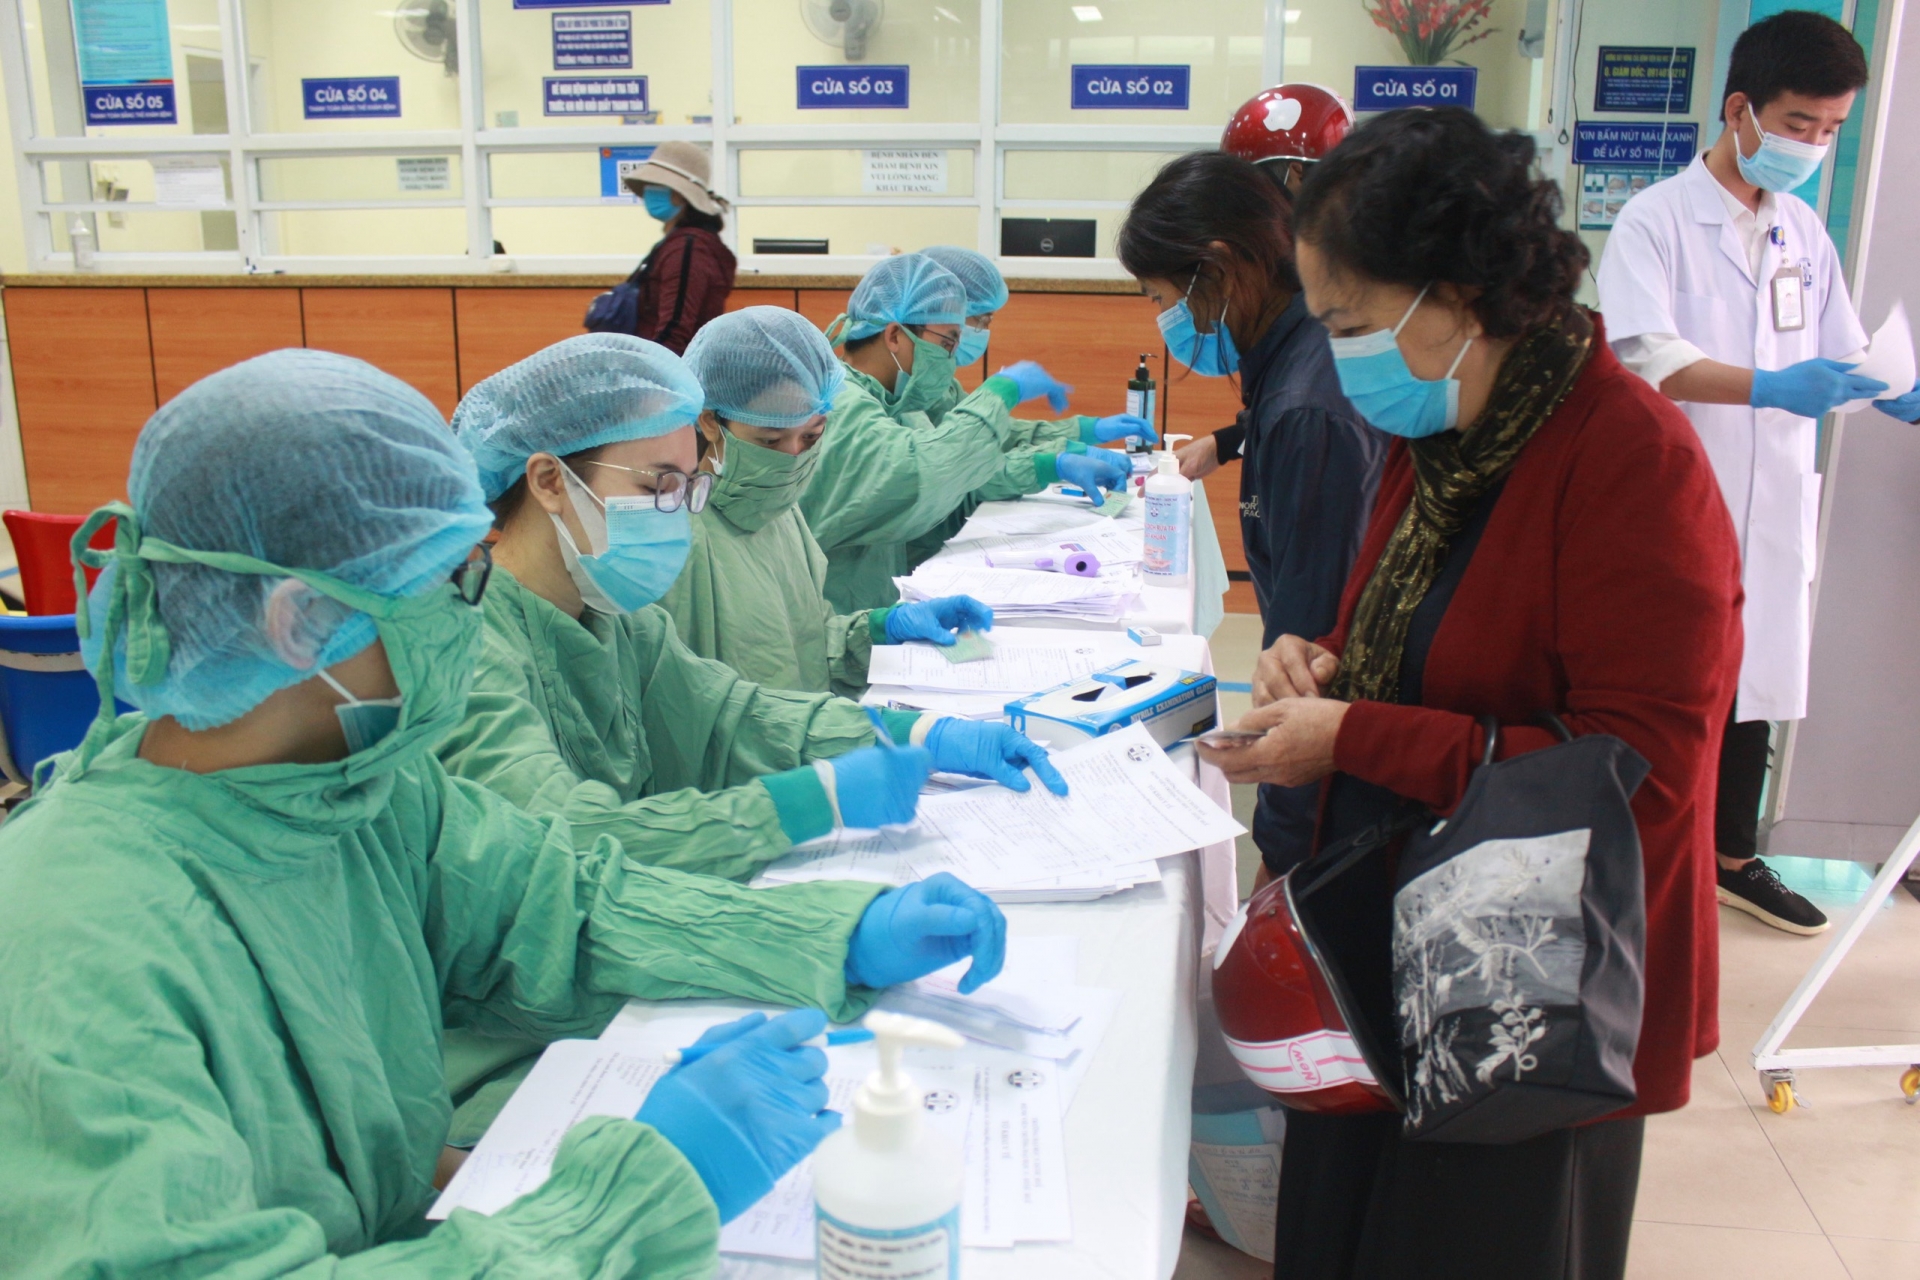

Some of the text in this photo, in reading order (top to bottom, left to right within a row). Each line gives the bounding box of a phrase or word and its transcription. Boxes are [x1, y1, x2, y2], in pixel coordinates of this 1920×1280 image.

[315, 84, 388, 103] CỬA SỐ 04
[811, 76, 893, 95] CỬA SỐ 03
[1088, 76, 1173, 95] CỬA SỐ 02
[1372, 78, 1458, 98] CỬA SỐ 01
[95, 92, 164, 110] CỬA SỐ 05
[1580, 128, 1693, 142] XIN BẤM NÚT MÀU XANH
[1593, 143, 1607, 158] ĐỂ
[1609, 144, 1627, 158] LẤY
[1629, 145, 1642, 158] SỐ
[1664, 148, 1677, 160] TỰ
[924, 162, 939, 170] XIN
[871, 173, 885, 181] VUI
[913, 173, 939, 181] MANG
[1238, 501, 1257, 510] NOR
[1243, 509, 1260, 518] FAC
[1155, 688, 1195, 713] EXAMINATION
[1292, 1050, 1317, 1080] New
